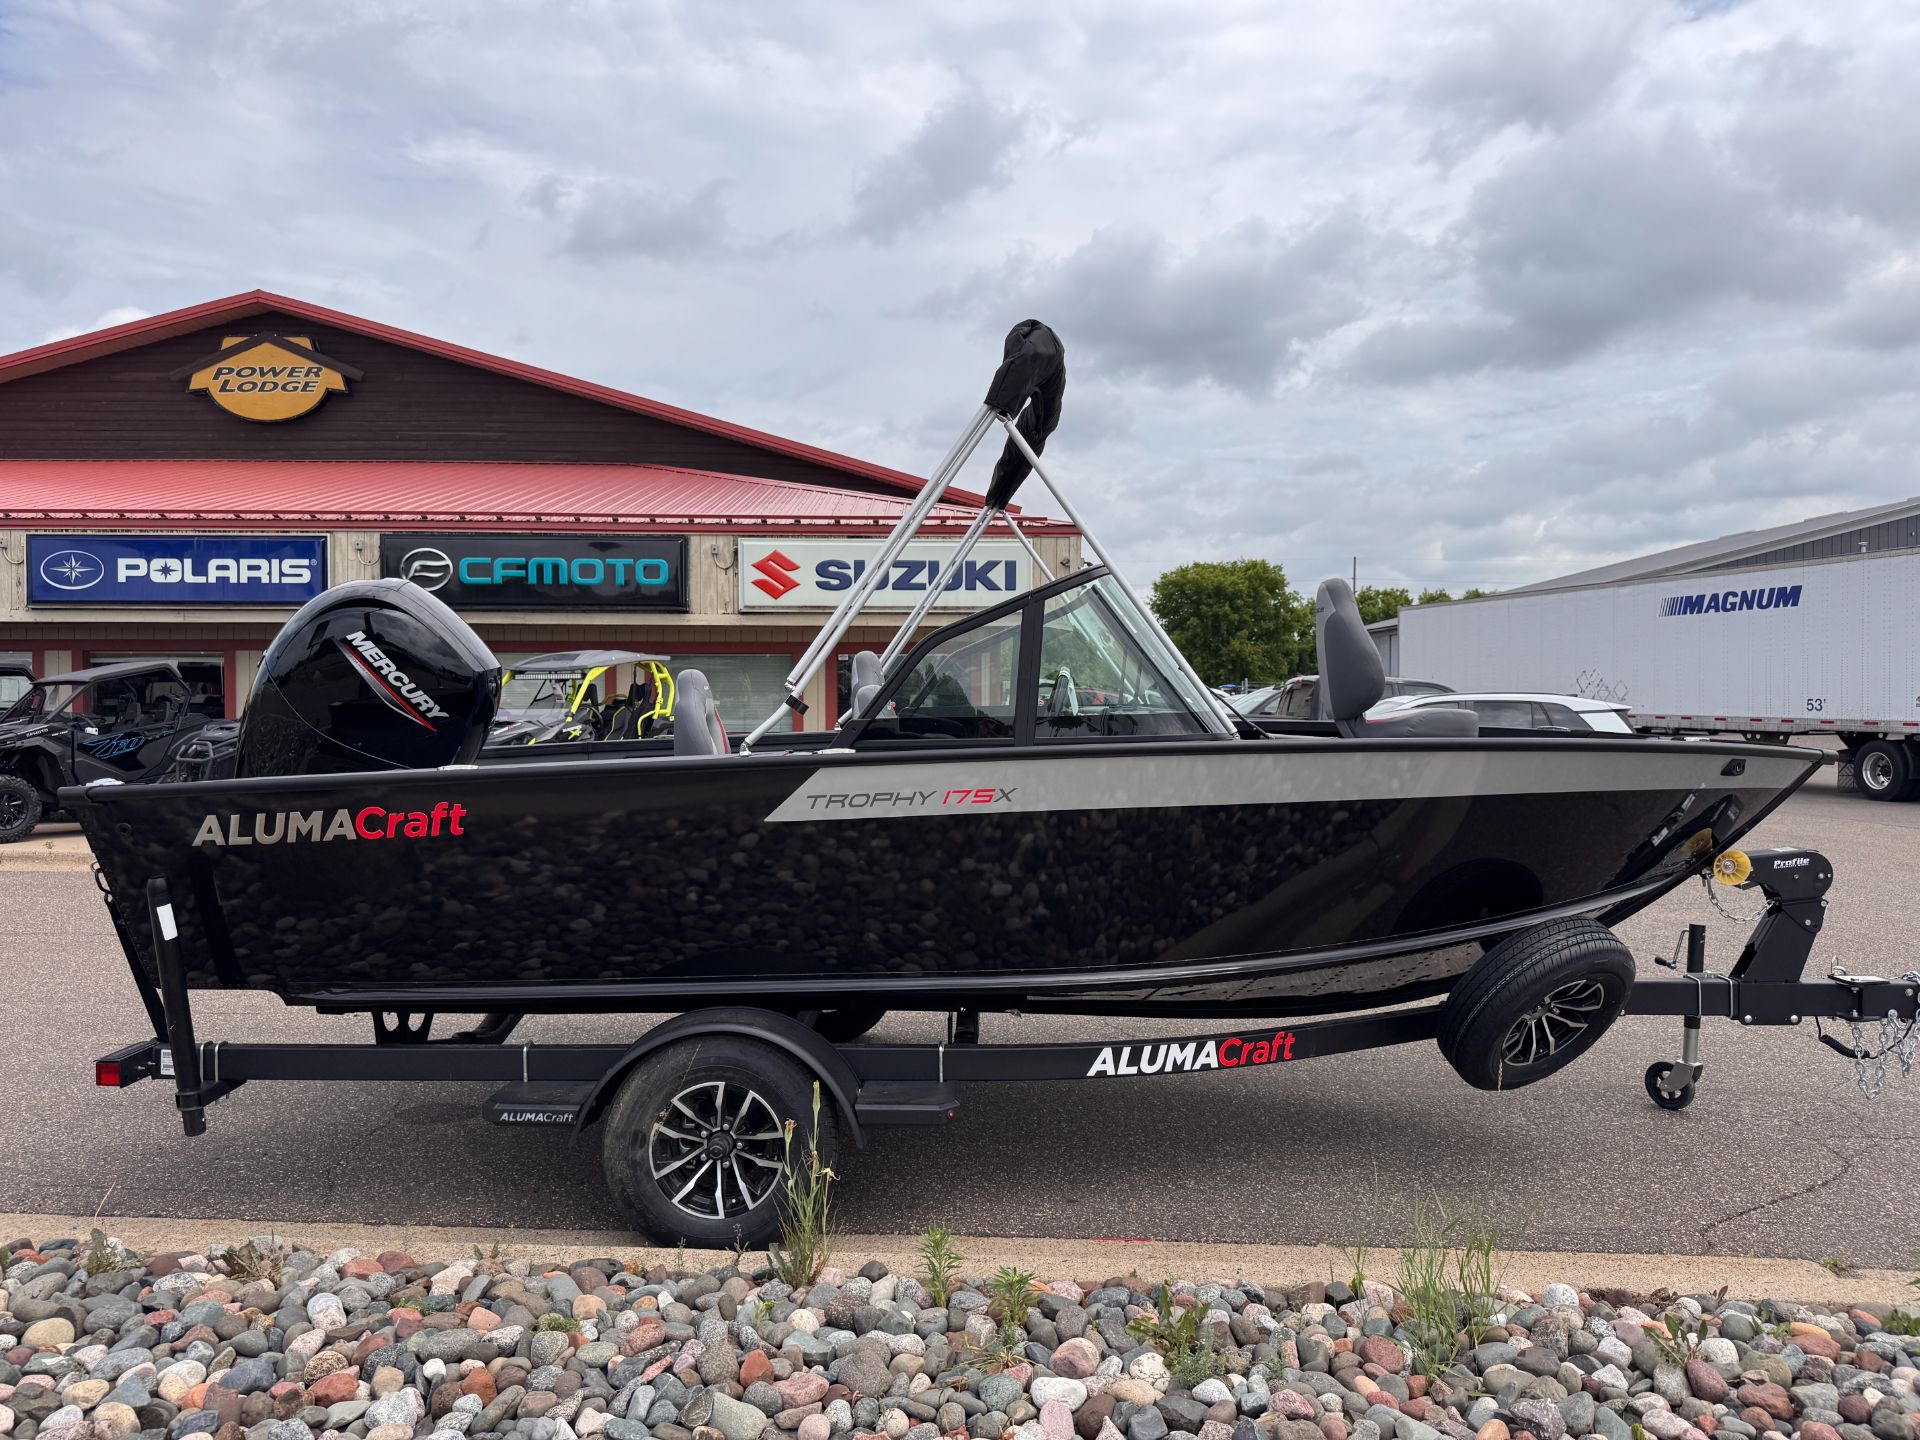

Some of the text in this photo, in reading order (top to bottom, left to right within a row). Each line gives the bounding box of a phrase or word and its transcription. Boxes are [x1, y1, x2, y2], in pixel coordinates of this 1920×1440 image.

[212, 366, 324, 381] POWER
[218, 379, 319, 393] LODGE
[459, 557, 669, 585] CFMOTO
[1682, 585, 1802, 615] MAGNUM
[345, 630, 450, 718] MERCURY
[806, 787, 1018, 809] TROPHY 175X
[191, 801, 467, 847] ALUMACraft
[1773, 857, 1810, 869] Profile
[1086, 1031, 1296, 1077] ALUMACraft
[499, 1111, 574, 1123] ALUMACraft
